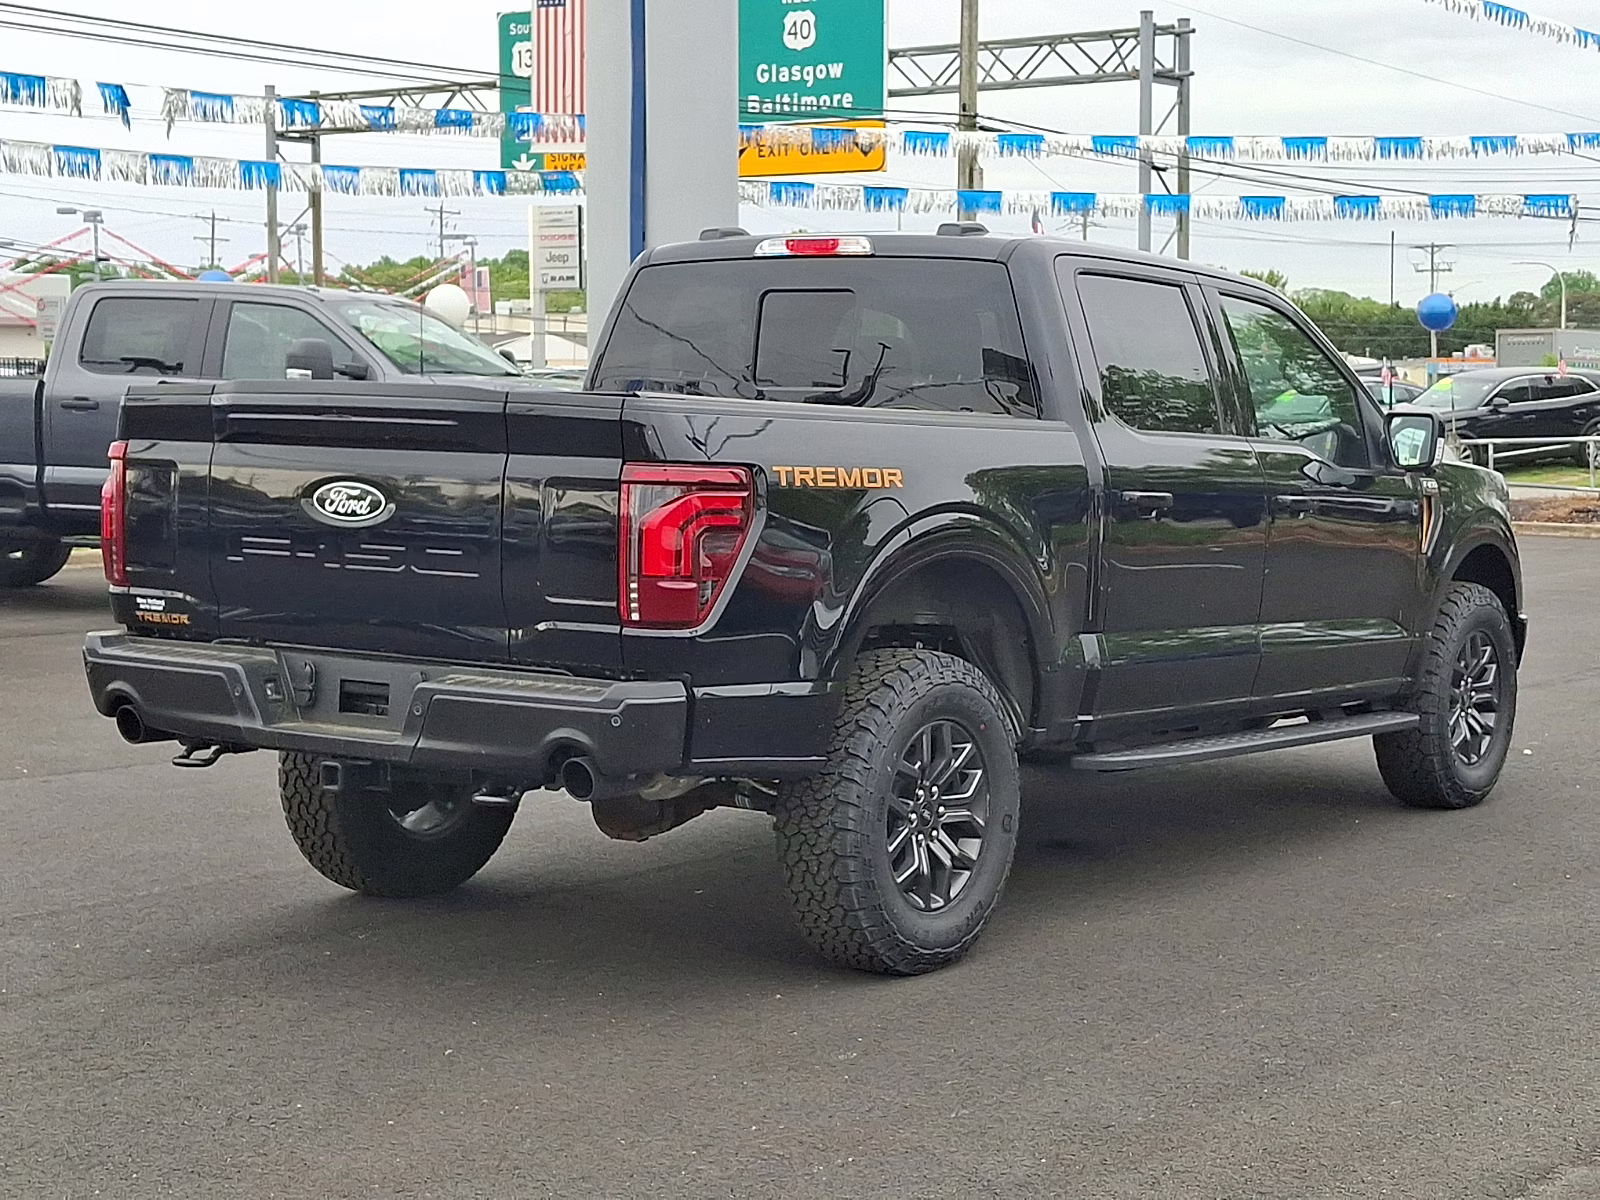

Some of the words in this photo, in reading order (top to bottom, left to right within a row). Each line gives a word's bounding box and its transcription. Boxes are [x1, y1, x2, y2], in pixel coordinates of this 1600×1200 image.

[509, 23, 532, 36] SOU
[787, 19, 812, 40] 40
[518, 49, 532, 69] 13
[756, 62, 844, 88] Glasgow
[747, 93, 853, 114] Baltimore
[550, 153, 586, 162] SIGNA
[758, 143, 788, 158] EXIT
[545, 251, 569, 264] Jeep
[772, 465, 904, 488] TREMOR
[324, 486, 372, 515] Ford
[135, 610, 191, 625] TREMOR
